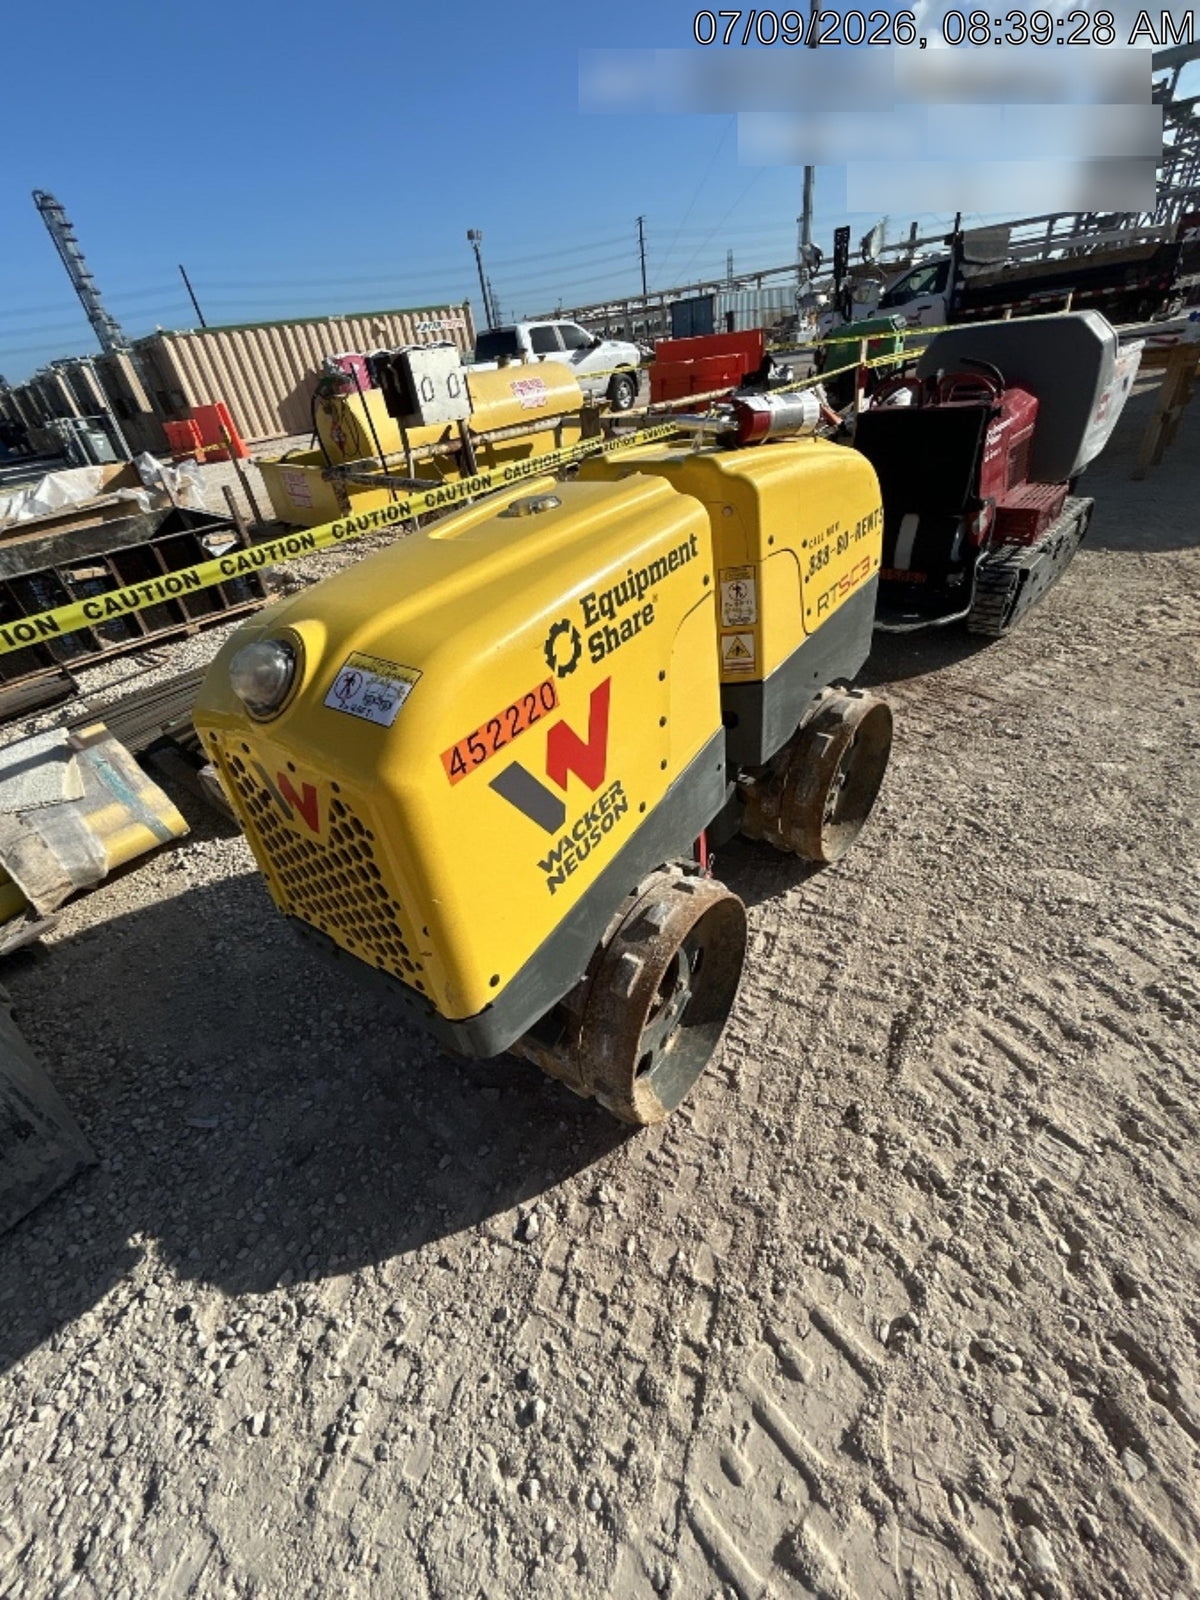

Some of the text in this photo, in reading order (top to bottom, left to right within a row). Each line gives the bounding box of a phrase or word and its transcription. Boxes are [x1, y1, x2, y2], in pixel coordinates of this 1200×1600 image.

[83, 569, 201, 619] CAUTION
[219, 532, 316, 576] CAUTION
[331, 501, 411, 539] CAUTION
[424, 474, 492, 507] CAUTION
[504, 452, 561, 480] CAUTION
[580, 533, 698, 629] Equipment
[588, 602, 655, 664] Share
[449, 681, 556, 777] 452220
[537, 780, 624, 874] WACKER
[547, 798, 629, 895] NEUSON
